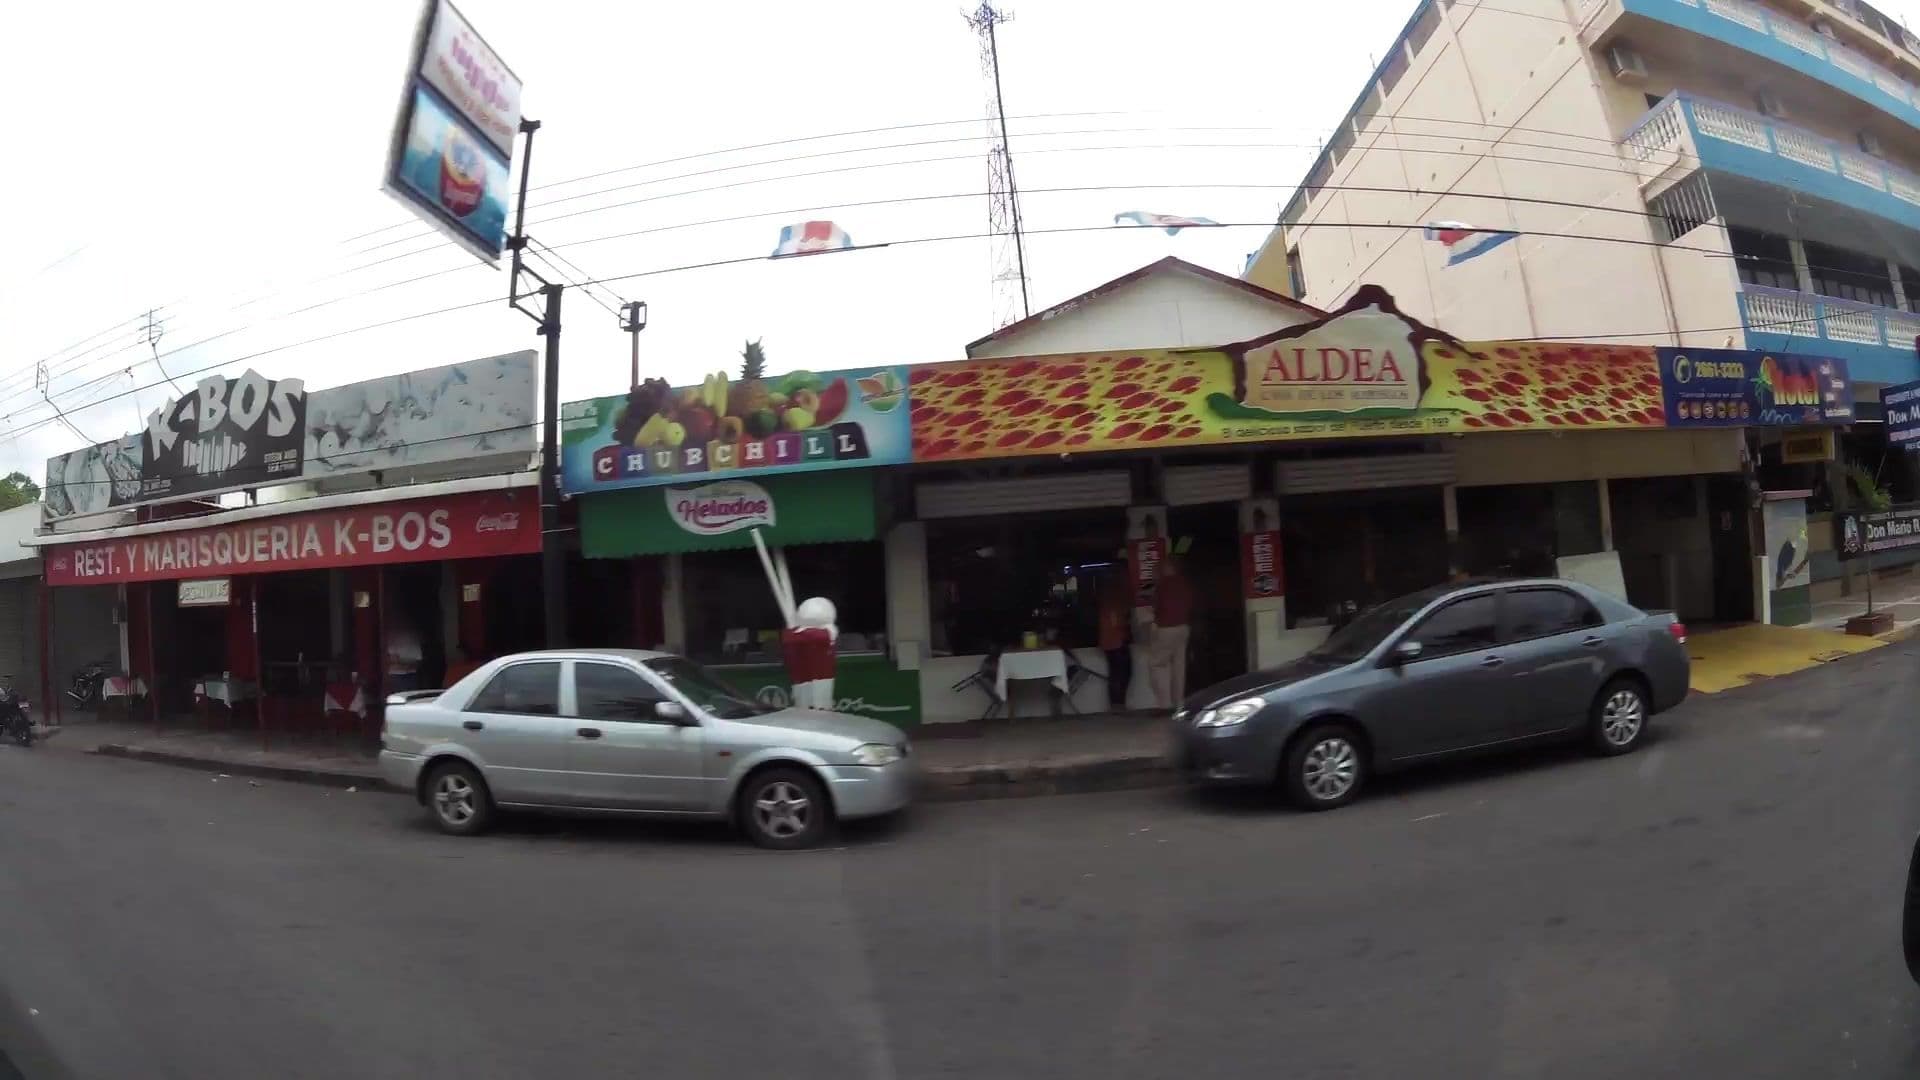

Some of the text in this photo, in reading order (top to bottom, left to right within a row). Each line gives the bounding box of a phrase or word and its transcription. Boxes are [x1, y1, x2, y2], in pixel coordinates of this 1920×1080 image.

[1261, 348, 1406, 382] ALDEA
[147, 368, 304, 461] K-BOS
[475, 512, 520, 533] Coca-Cola
[677, 496, 768, 526] Helados
[75, 509, 451, 577] REST. Y MARISQUERIA K-BOS
[1867, 524, 1886, 539] Don
